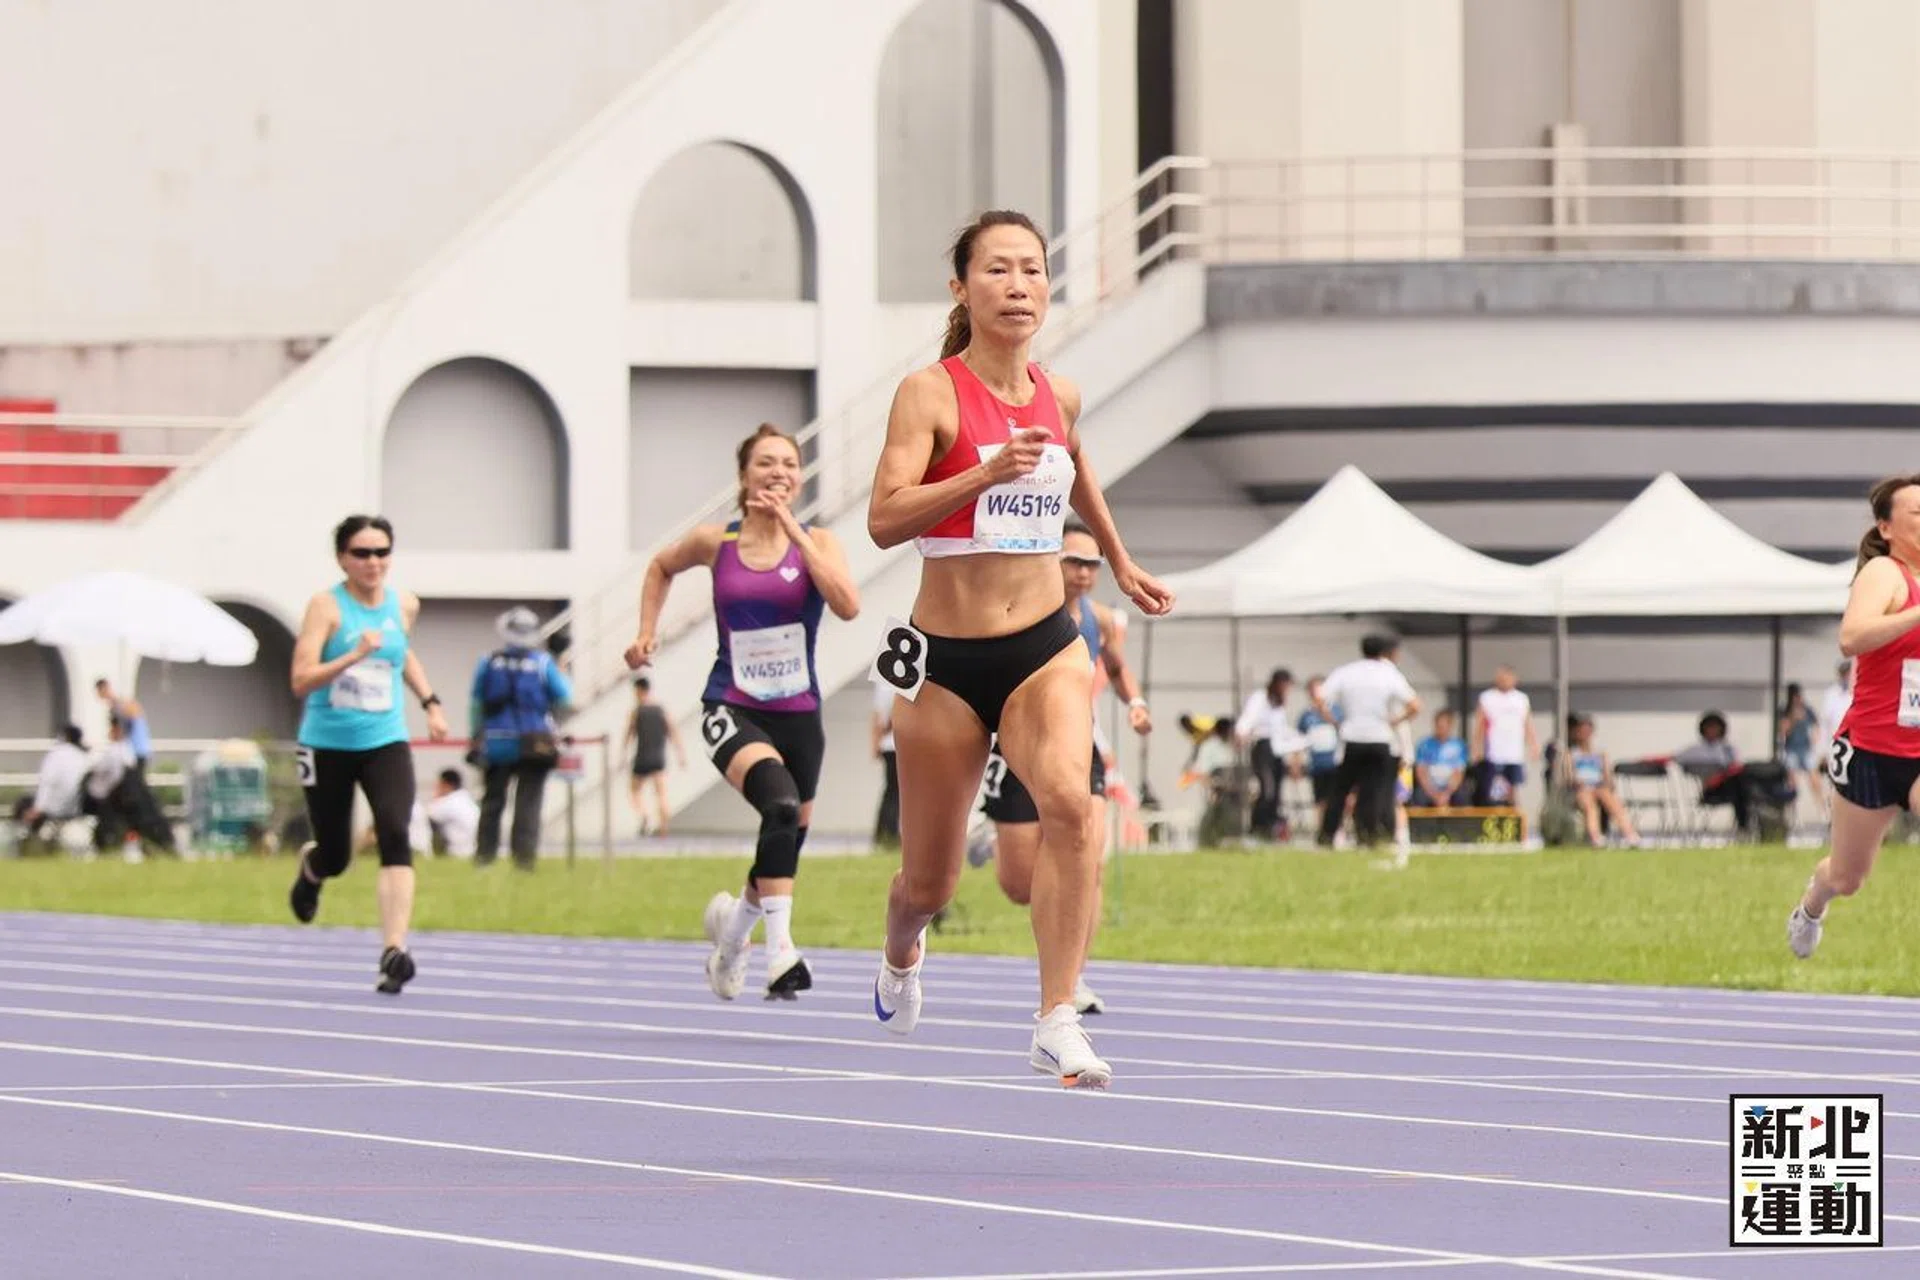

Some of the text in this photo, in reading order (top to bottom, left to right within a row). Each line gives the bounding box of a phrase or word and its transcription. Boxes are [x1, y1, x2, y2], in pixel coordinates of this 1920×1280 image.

[988, 494, 1062, 517] W45196
[877, 627, 921, 690] 8
[703, 717, 727, 746] 6
[1832, 740, 1848, 777] 3
